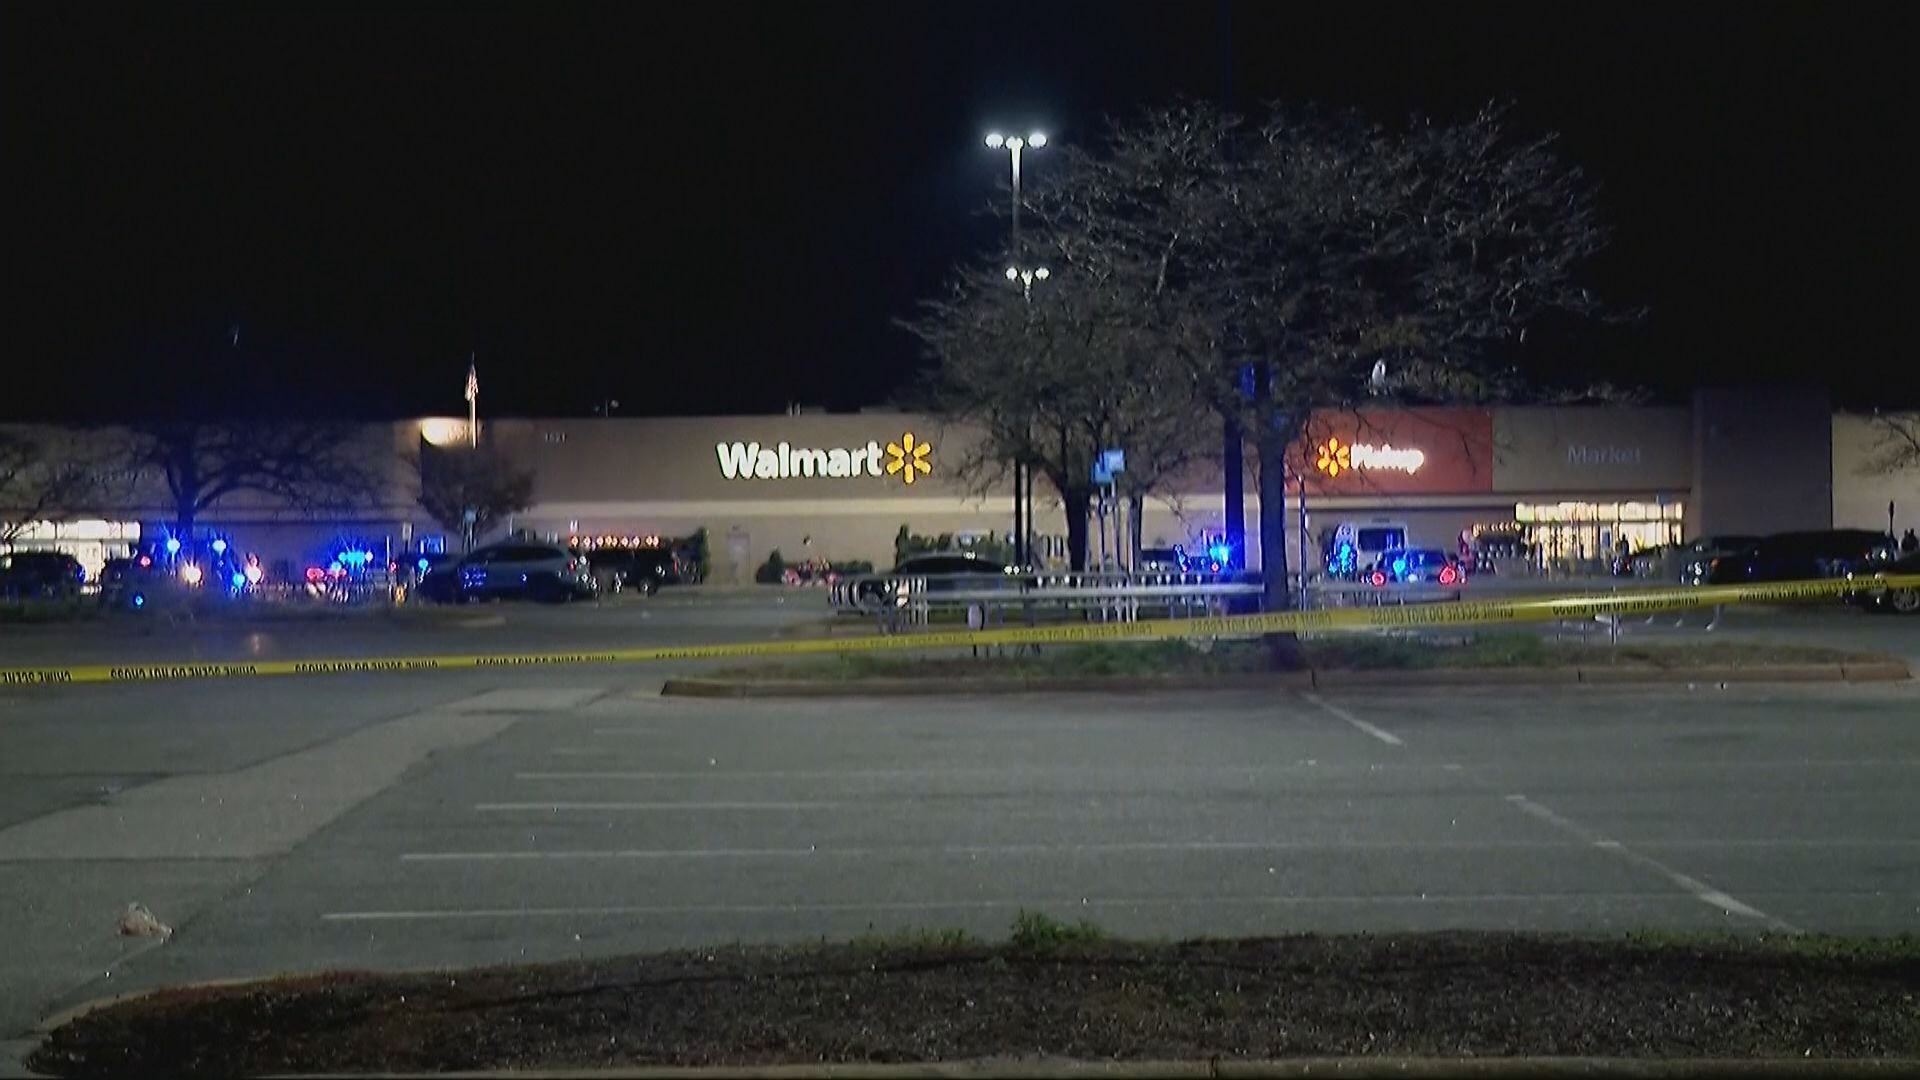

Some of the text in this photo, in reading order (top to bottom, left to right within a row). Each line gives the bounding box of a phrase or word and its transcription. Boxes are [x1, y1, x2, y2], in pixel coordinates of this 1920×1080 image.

[716, 441, 884, 480] Walmart
[1350, 443, 1425, 475] Pickup
[1567, 445, 1641, 464] Market
